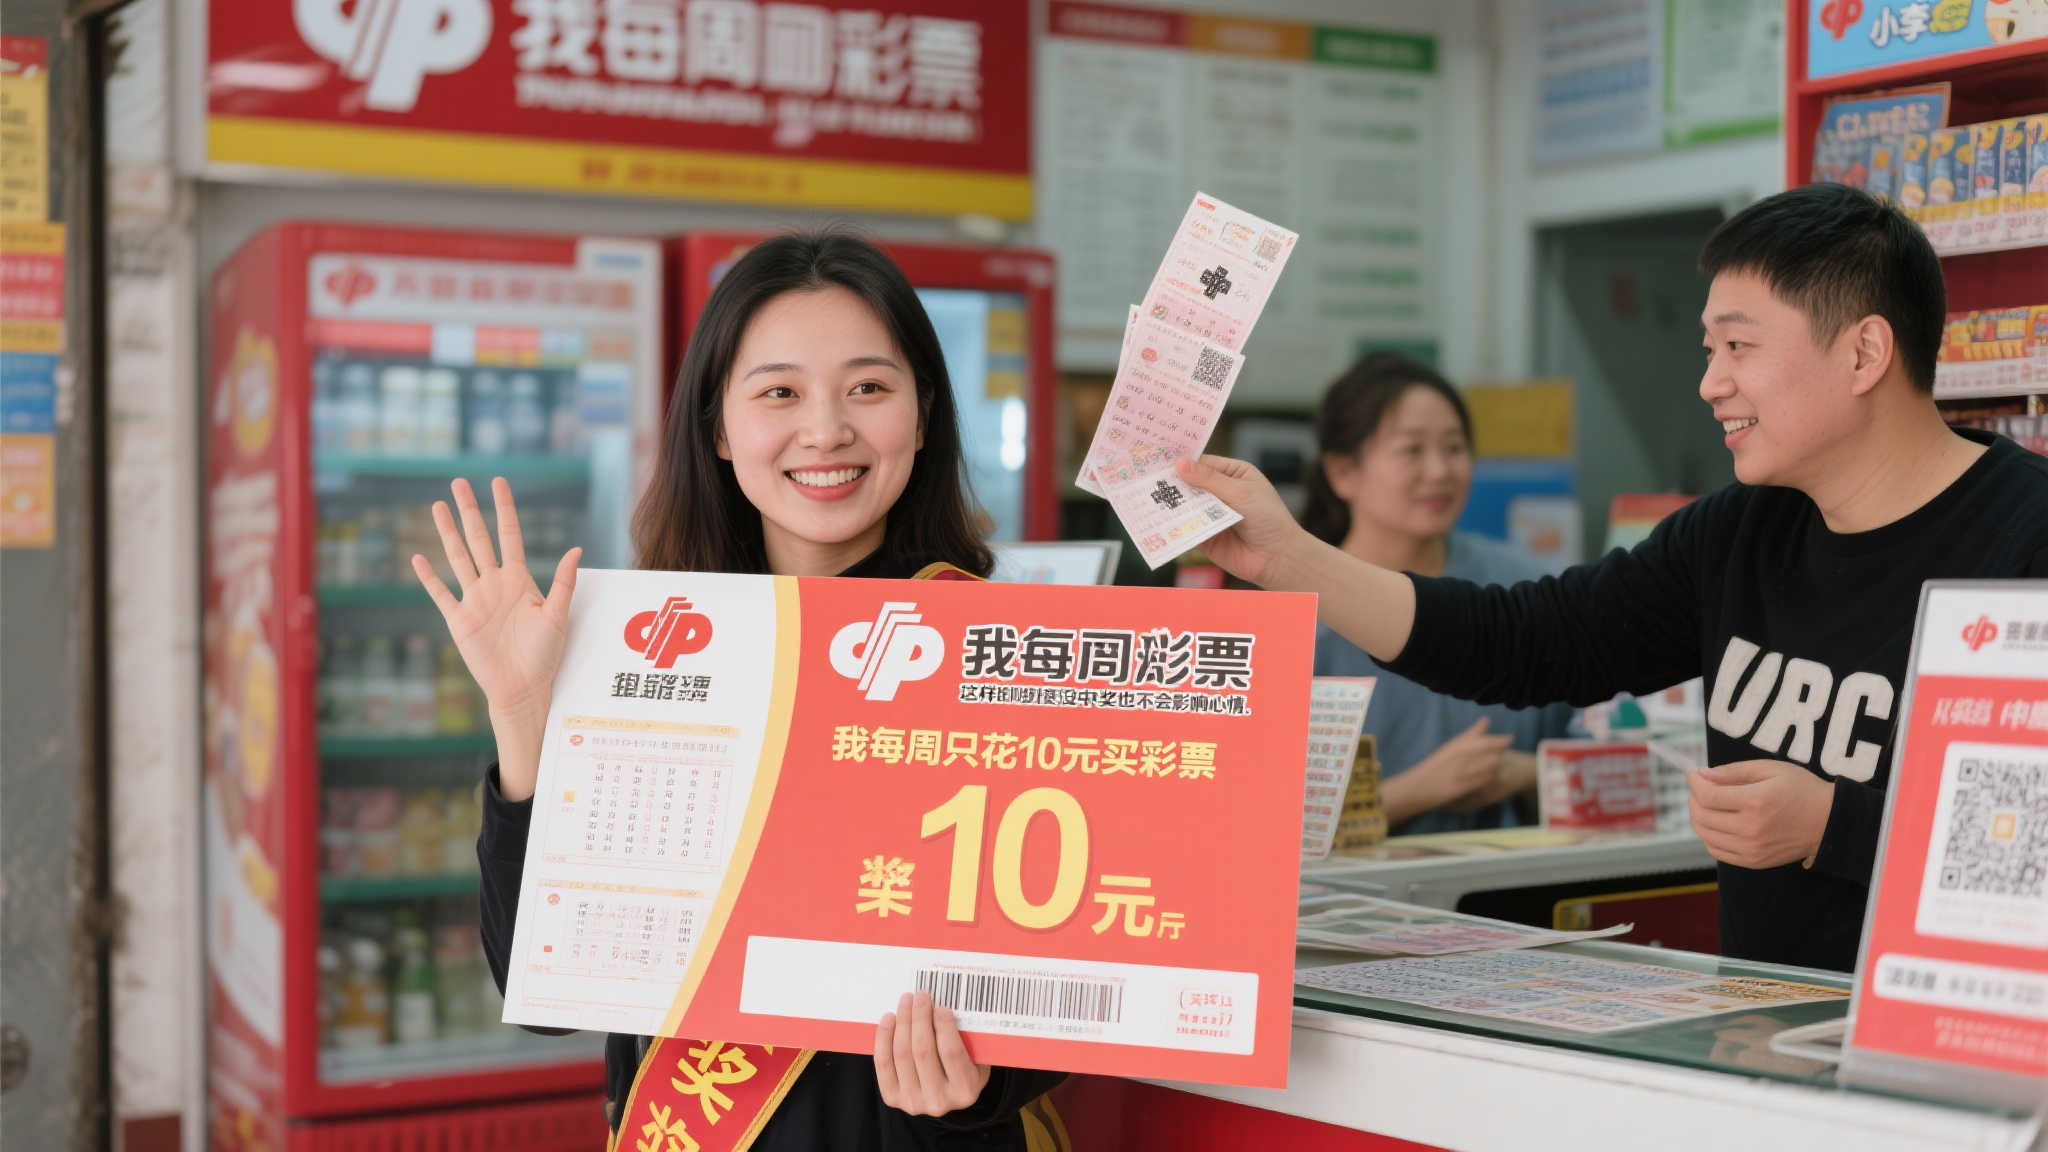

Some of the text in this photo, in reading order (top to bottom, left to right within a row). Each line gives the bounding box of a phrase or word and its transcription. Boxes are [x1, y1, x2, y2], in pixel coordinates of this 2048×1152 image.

[963, 626, 1253, 689] 我每周彩票
[1707, 635, 1895, 782] URC
[832, 725, 1218, 781] 我每周只花10元买彩票
